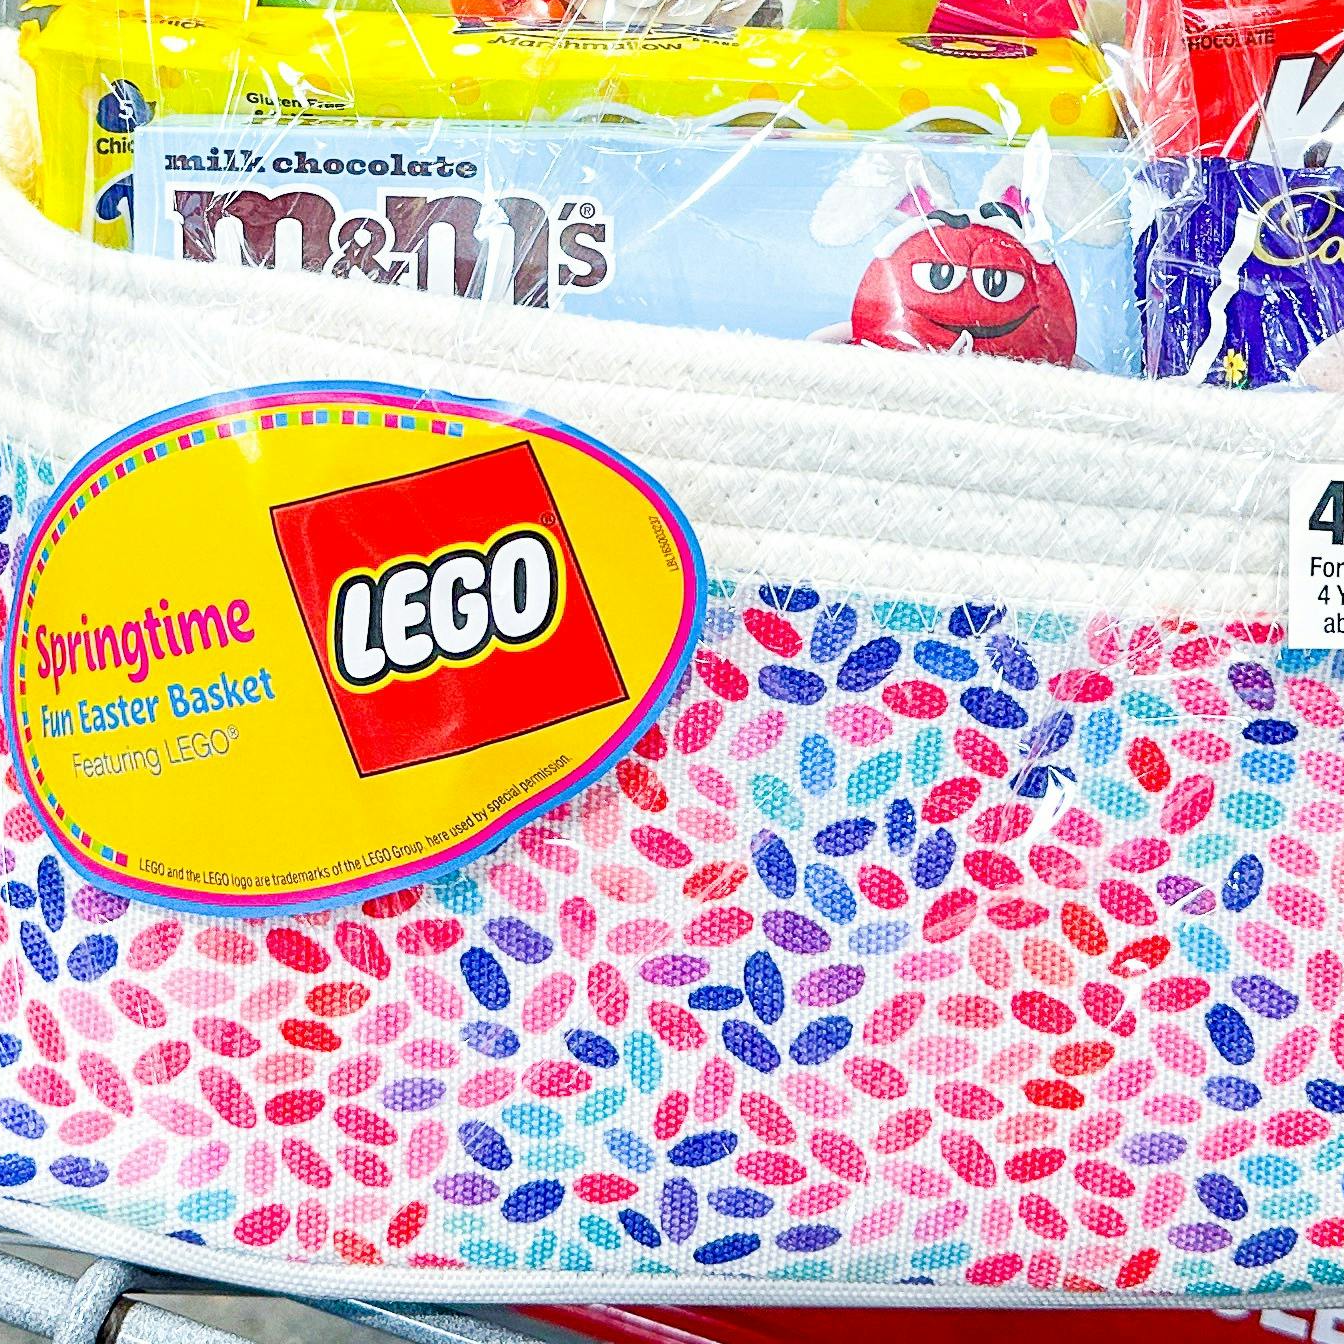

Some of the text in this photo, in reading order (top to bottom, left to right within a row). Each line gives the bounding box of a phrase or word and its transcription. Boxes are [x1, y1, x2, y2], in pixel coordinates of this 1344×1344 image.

[165, 148, 478, 178] milk chocolate
[1310, 556, 1344, 578] For
[338, 532, 556, 684] LEGO
[1317, 585, 1330, 605] 4
[36, 598, 255, 696] Springtime
[42, 667, 276, 738] Fun Easter Basket
[72, 744, 162, 779] Featuring
[140, 858, 165, 876] LEGO
[167, 867, 184, 880] and
[186, 869, 201, 883] the
[203, 871, 229, 887] LEGO
[232, 873, 253, 890] logo
[255, 876, 271, 887] are
[272, 866, 331, 886] trademarks
[332, 861, 342, 876] of
[344, 858, 362, 872] the
[362, 847, 392, 868] LEGO
[425, 830, 450, 848] here
[449, 816, 475, 837] used
[472, 807, 489, 822] by
[487, 783, 521, 813] special
